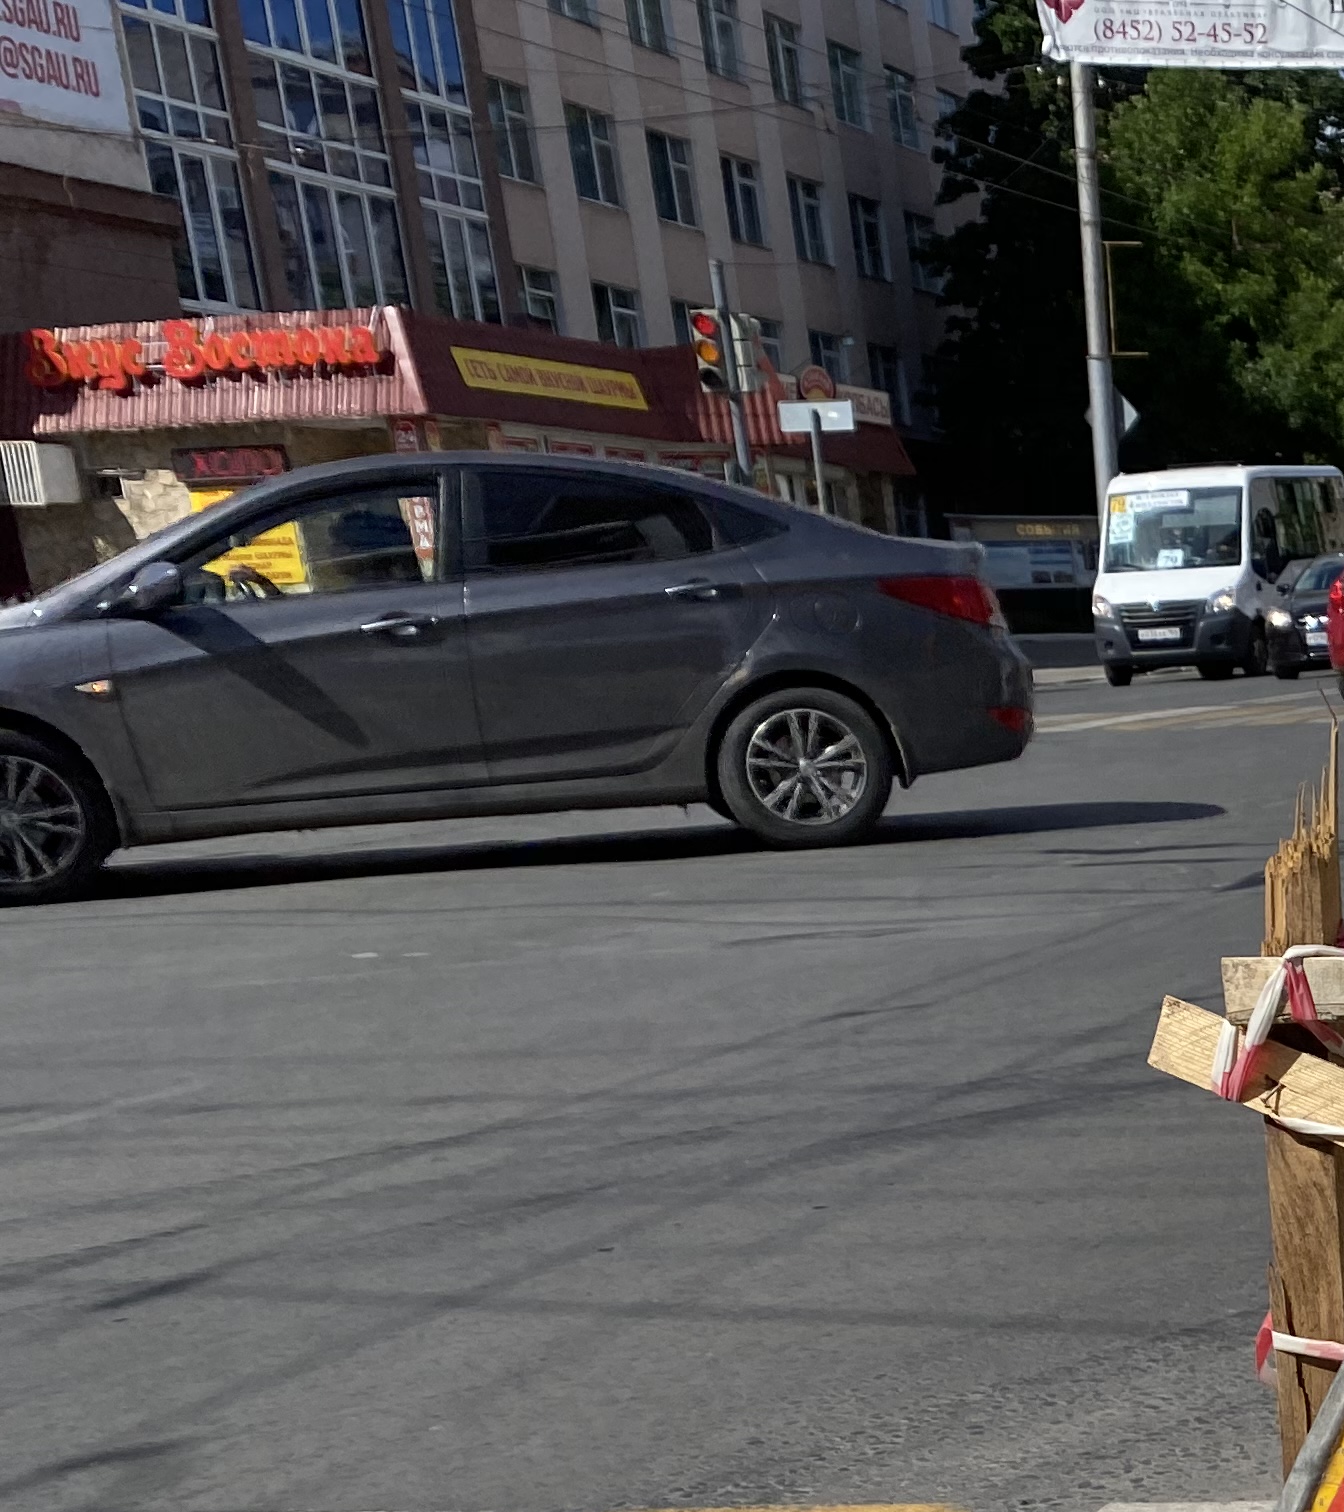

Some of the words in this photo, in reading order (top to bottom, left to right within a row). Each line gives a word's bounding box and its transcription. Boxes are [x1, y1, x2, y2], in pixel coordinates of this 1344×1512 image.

[1093, 18, 1163, 43] (8452)
[1171, 20, 1269, 45] 52-45-52
[26, 329, 145, 390] Вкус
[163, 319, 380, 379] Востока
